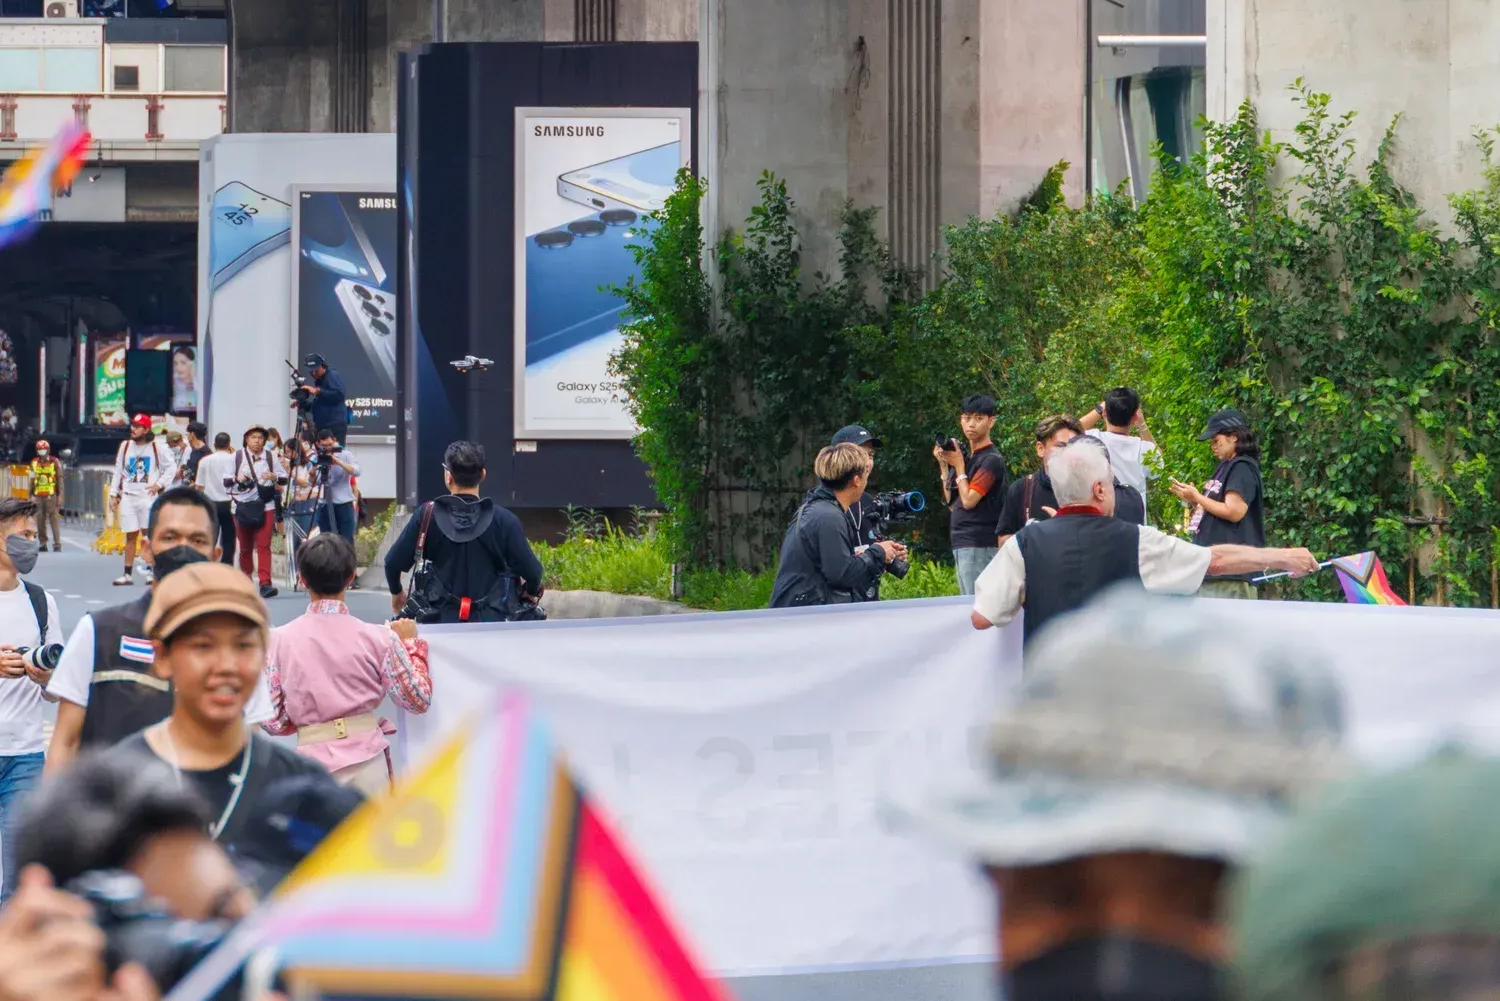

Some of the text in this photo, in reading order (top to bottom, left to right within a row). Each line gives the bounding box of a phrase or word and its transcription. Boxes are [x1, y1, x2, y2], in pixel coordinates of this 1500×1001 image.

[534, 125, 605, 137] SAMSUNG
[224, 211, 247, 226] 45
[557, 382, 619, 393] Galaxy S25
[355, 397, 371, 407] S25
[371, 397, 393, 407] Ultra
[575, 396, 608, 405] Galaxy
